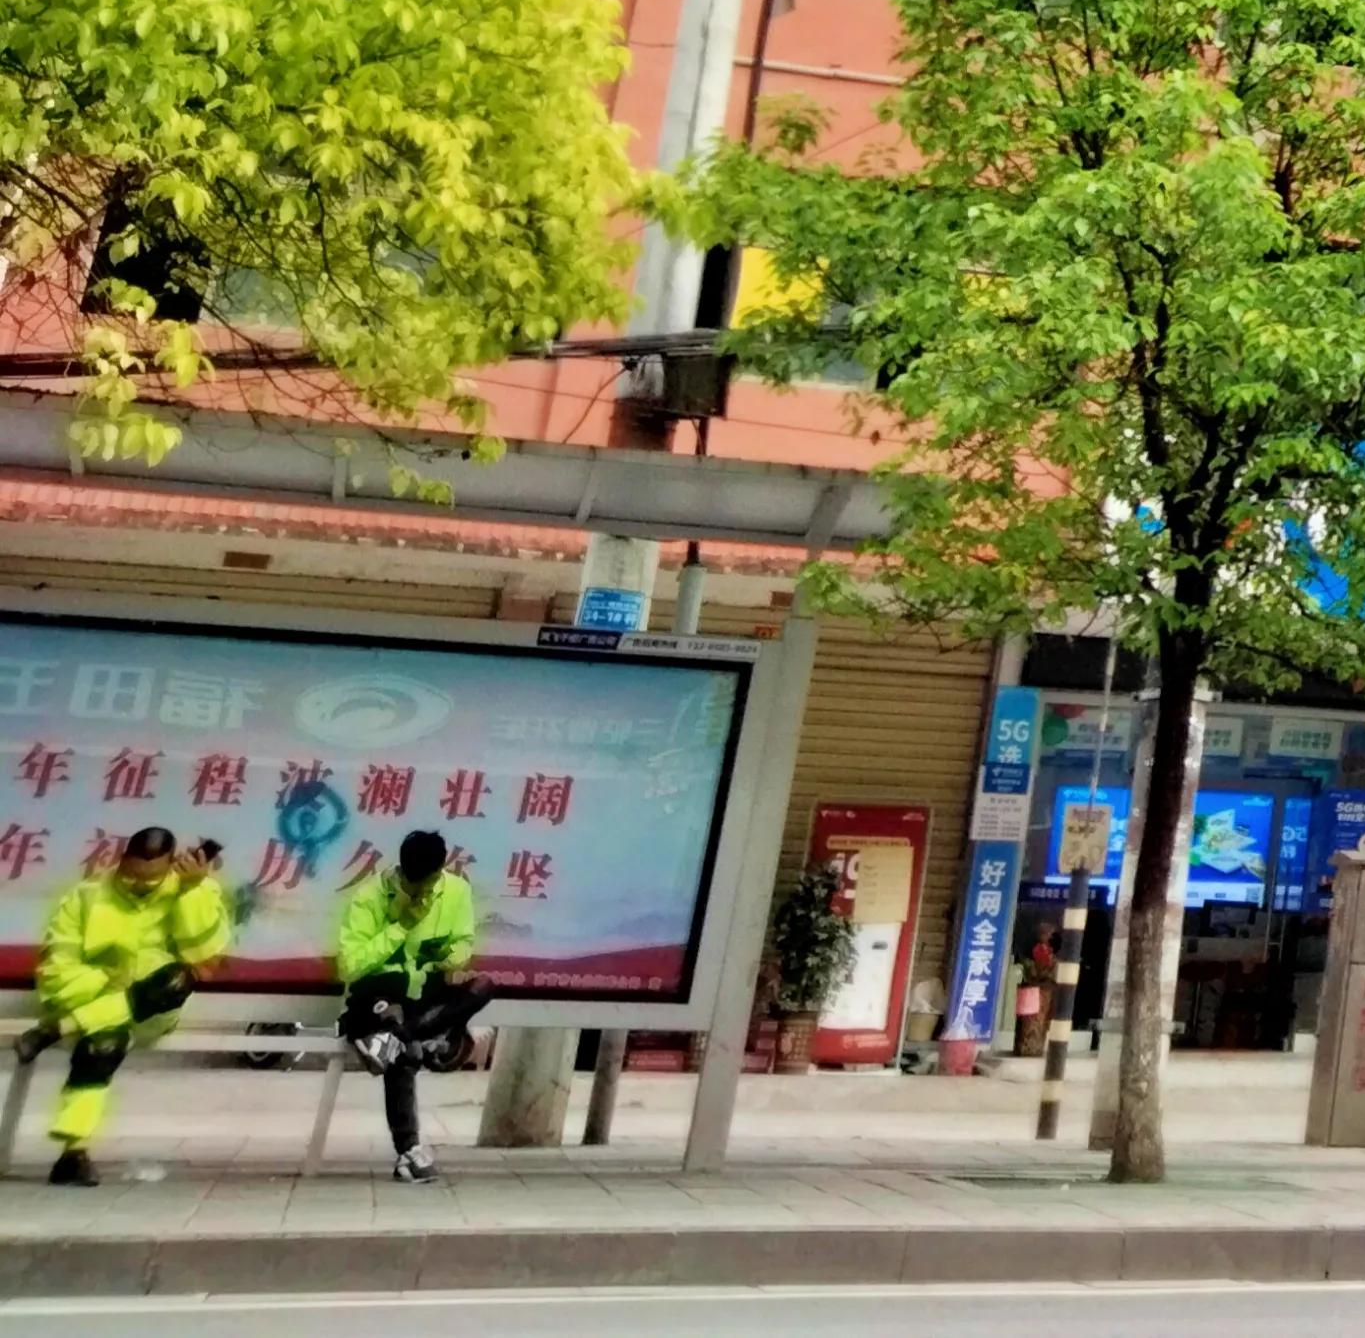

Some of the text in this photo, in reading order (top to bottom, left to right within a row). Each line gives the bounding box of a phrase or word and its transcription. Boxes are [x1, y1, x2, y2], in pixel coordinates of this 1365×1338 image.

[963, 860, 1006, 1007] 好网全家享
